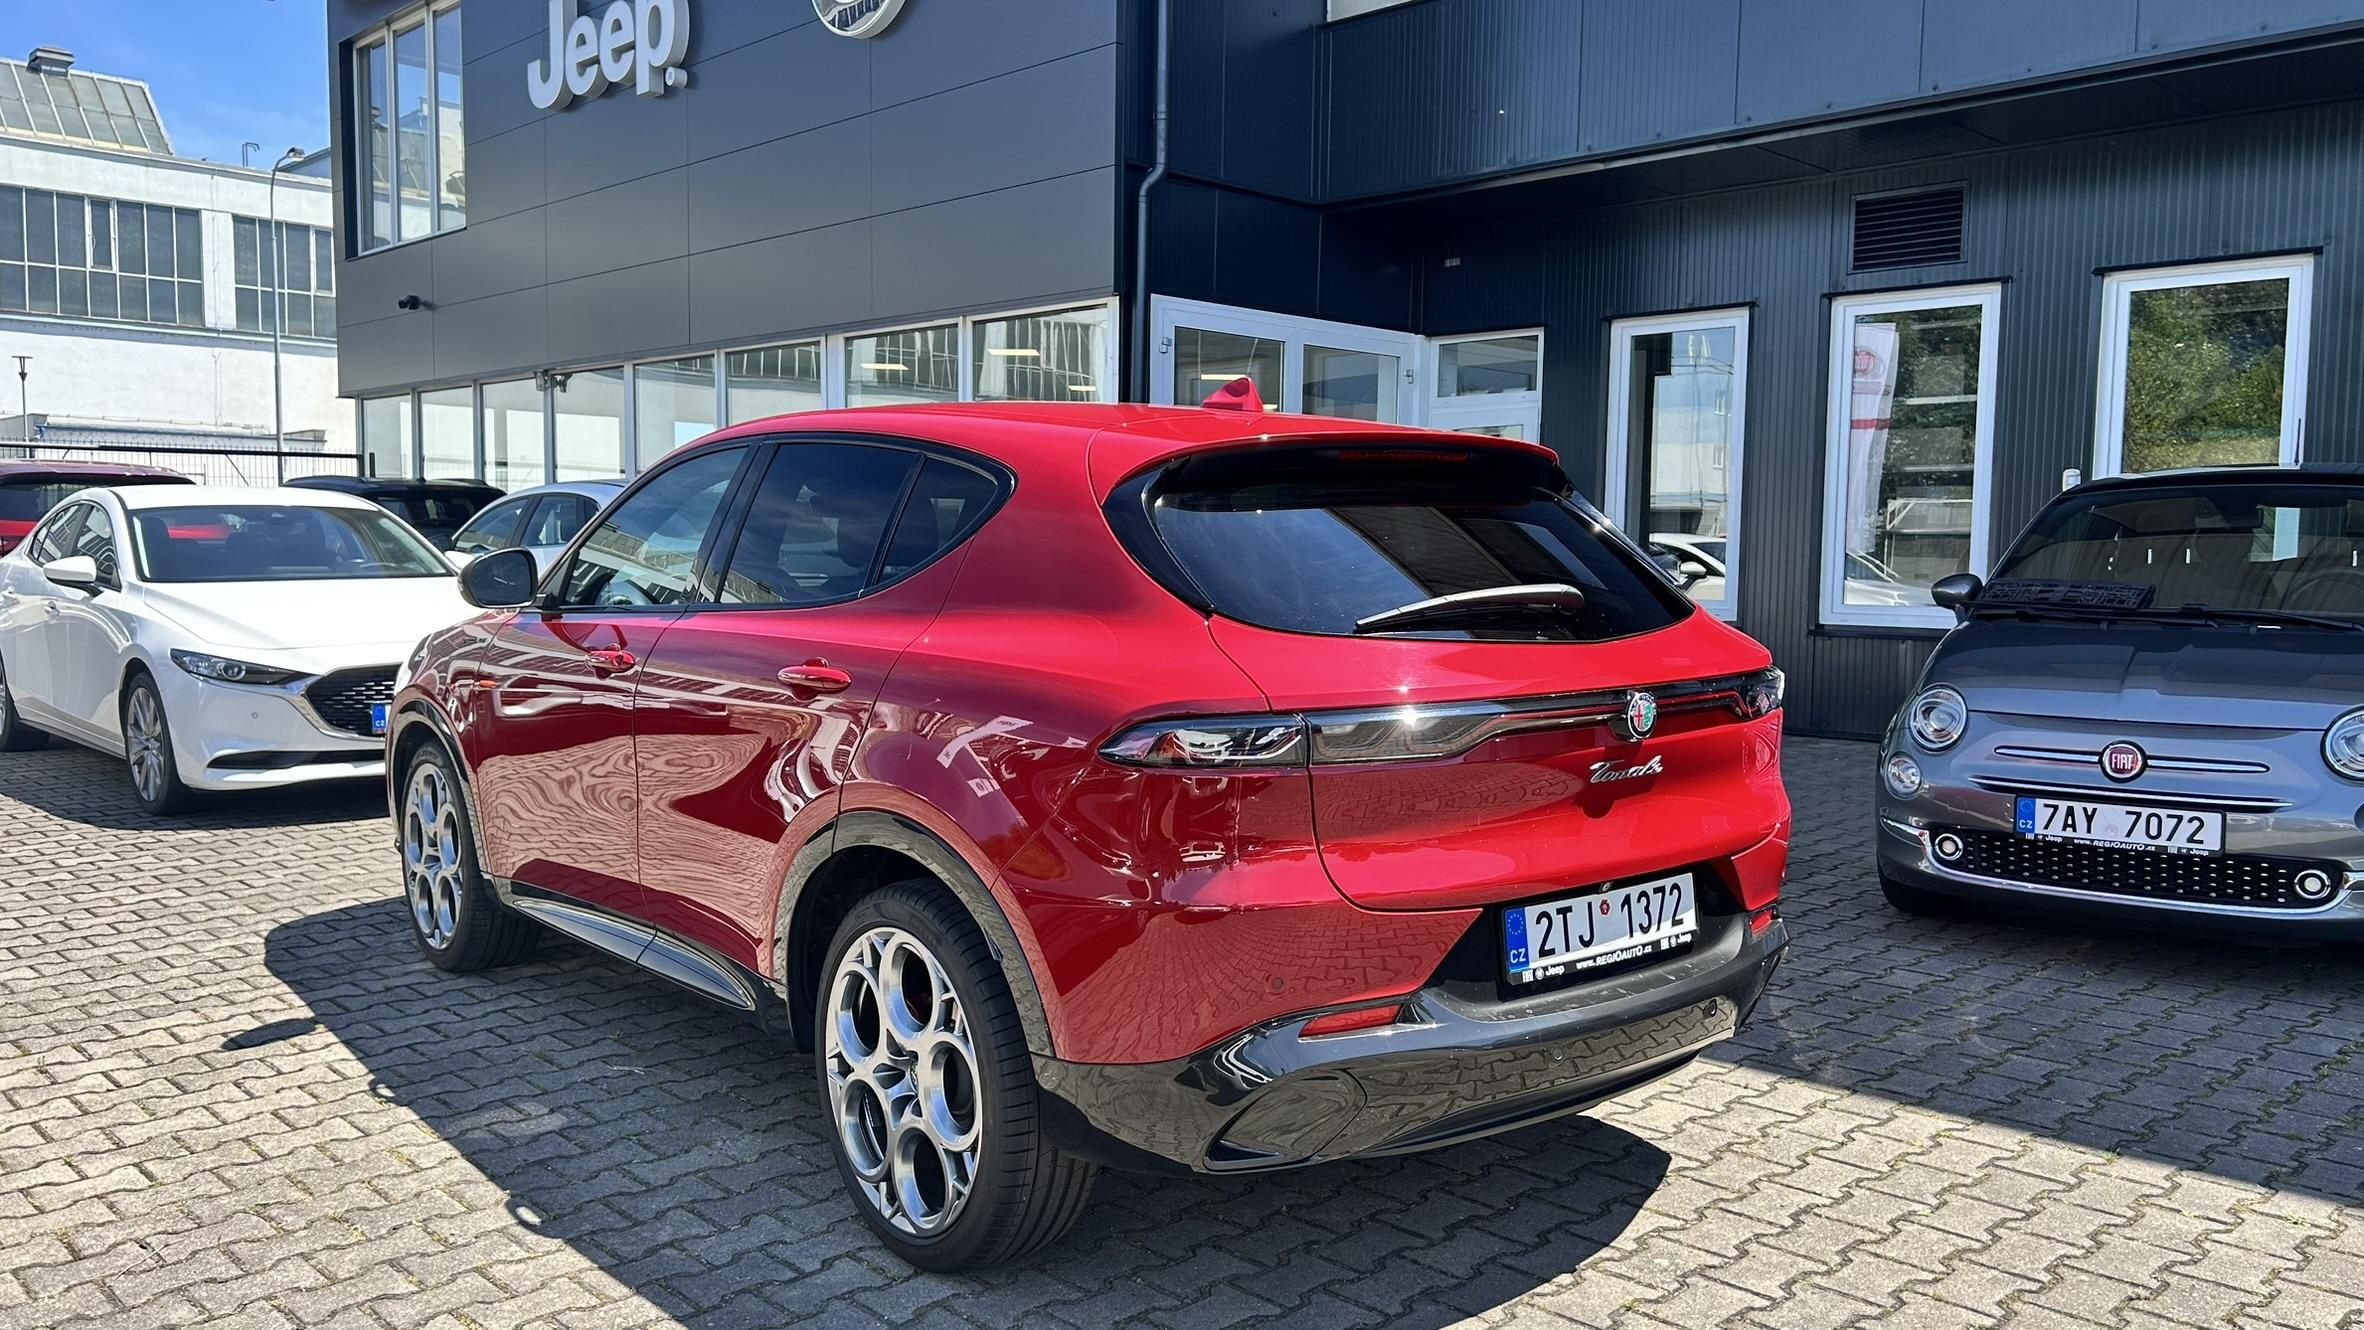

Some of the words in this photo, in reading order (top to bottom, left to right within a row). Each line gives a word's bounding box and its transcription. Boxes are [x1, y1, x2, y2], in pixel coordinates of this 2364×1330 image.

[2111, 753, 2134, 770] FIAT
[2019, 819, 2033, 829] CZ
[2042, 803, 2098, 835] 7AY
[2125, 810, 2205, 845] 7072
[1535, 901, 1595, 959] 2TJ
[1620, 882, 1684, 938] 1372
[1510, 948, 1526, 963] CZ
